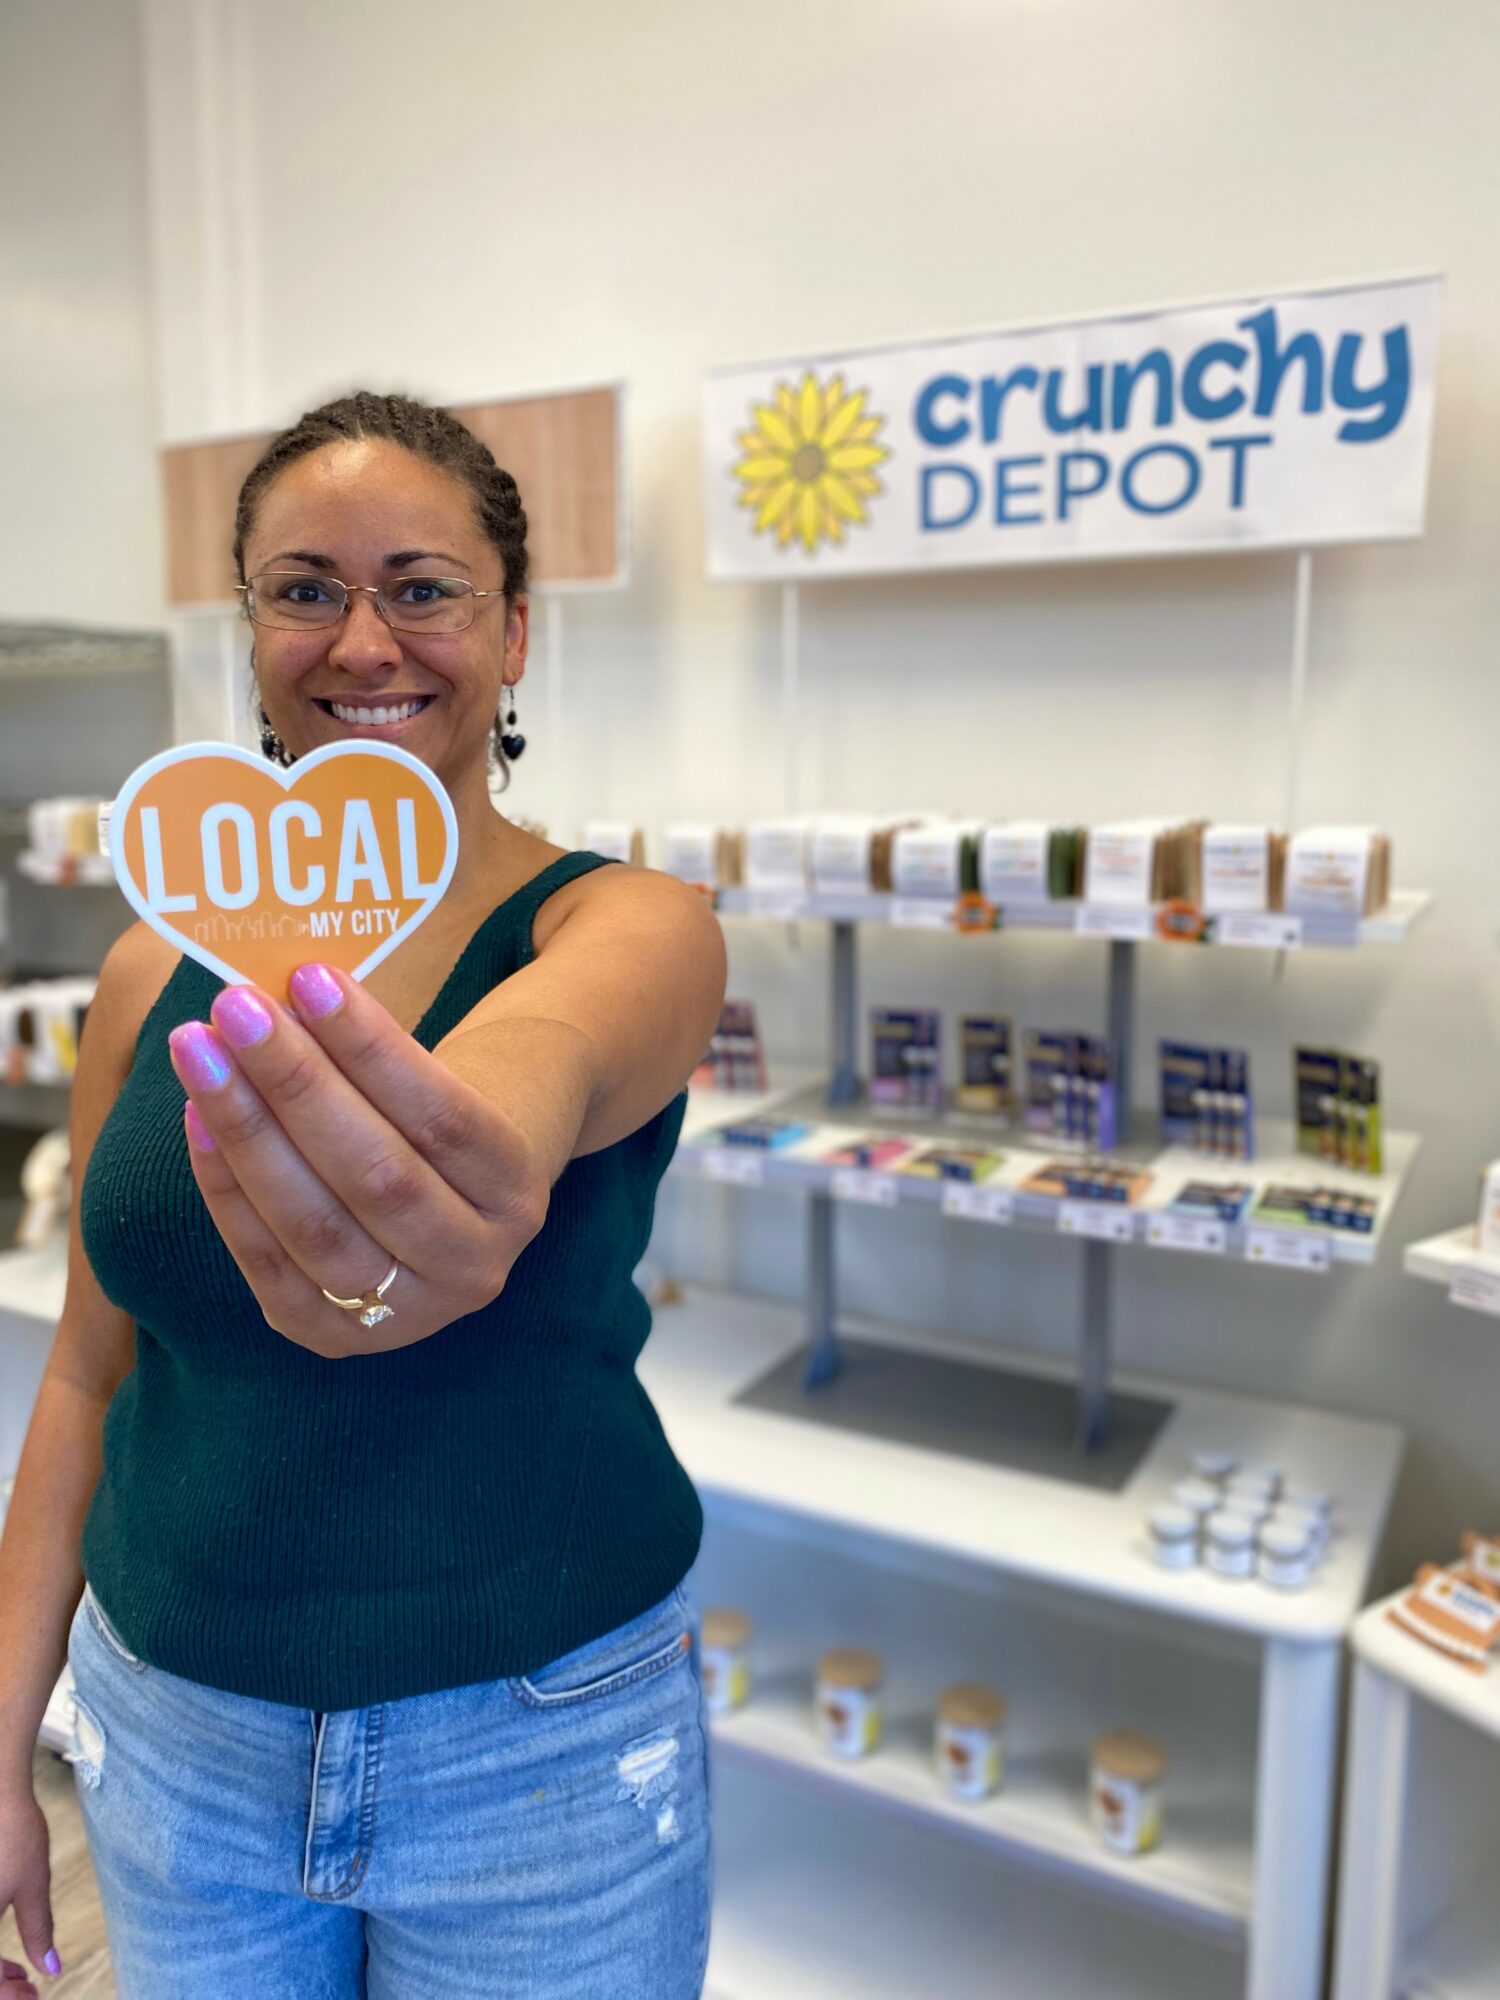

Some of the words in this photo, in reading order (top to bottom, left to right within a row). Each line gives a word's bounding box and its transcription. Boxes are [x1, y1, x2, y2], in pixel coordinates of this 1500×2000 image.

[914, 305, 1412, 446] crunchy
[919, 433, 1274, 532] DEPOT
[140, 798, 437, 913] LOCAL
[310, 910, 344, 938] MY
[351, 908, 400, 936] CITY
